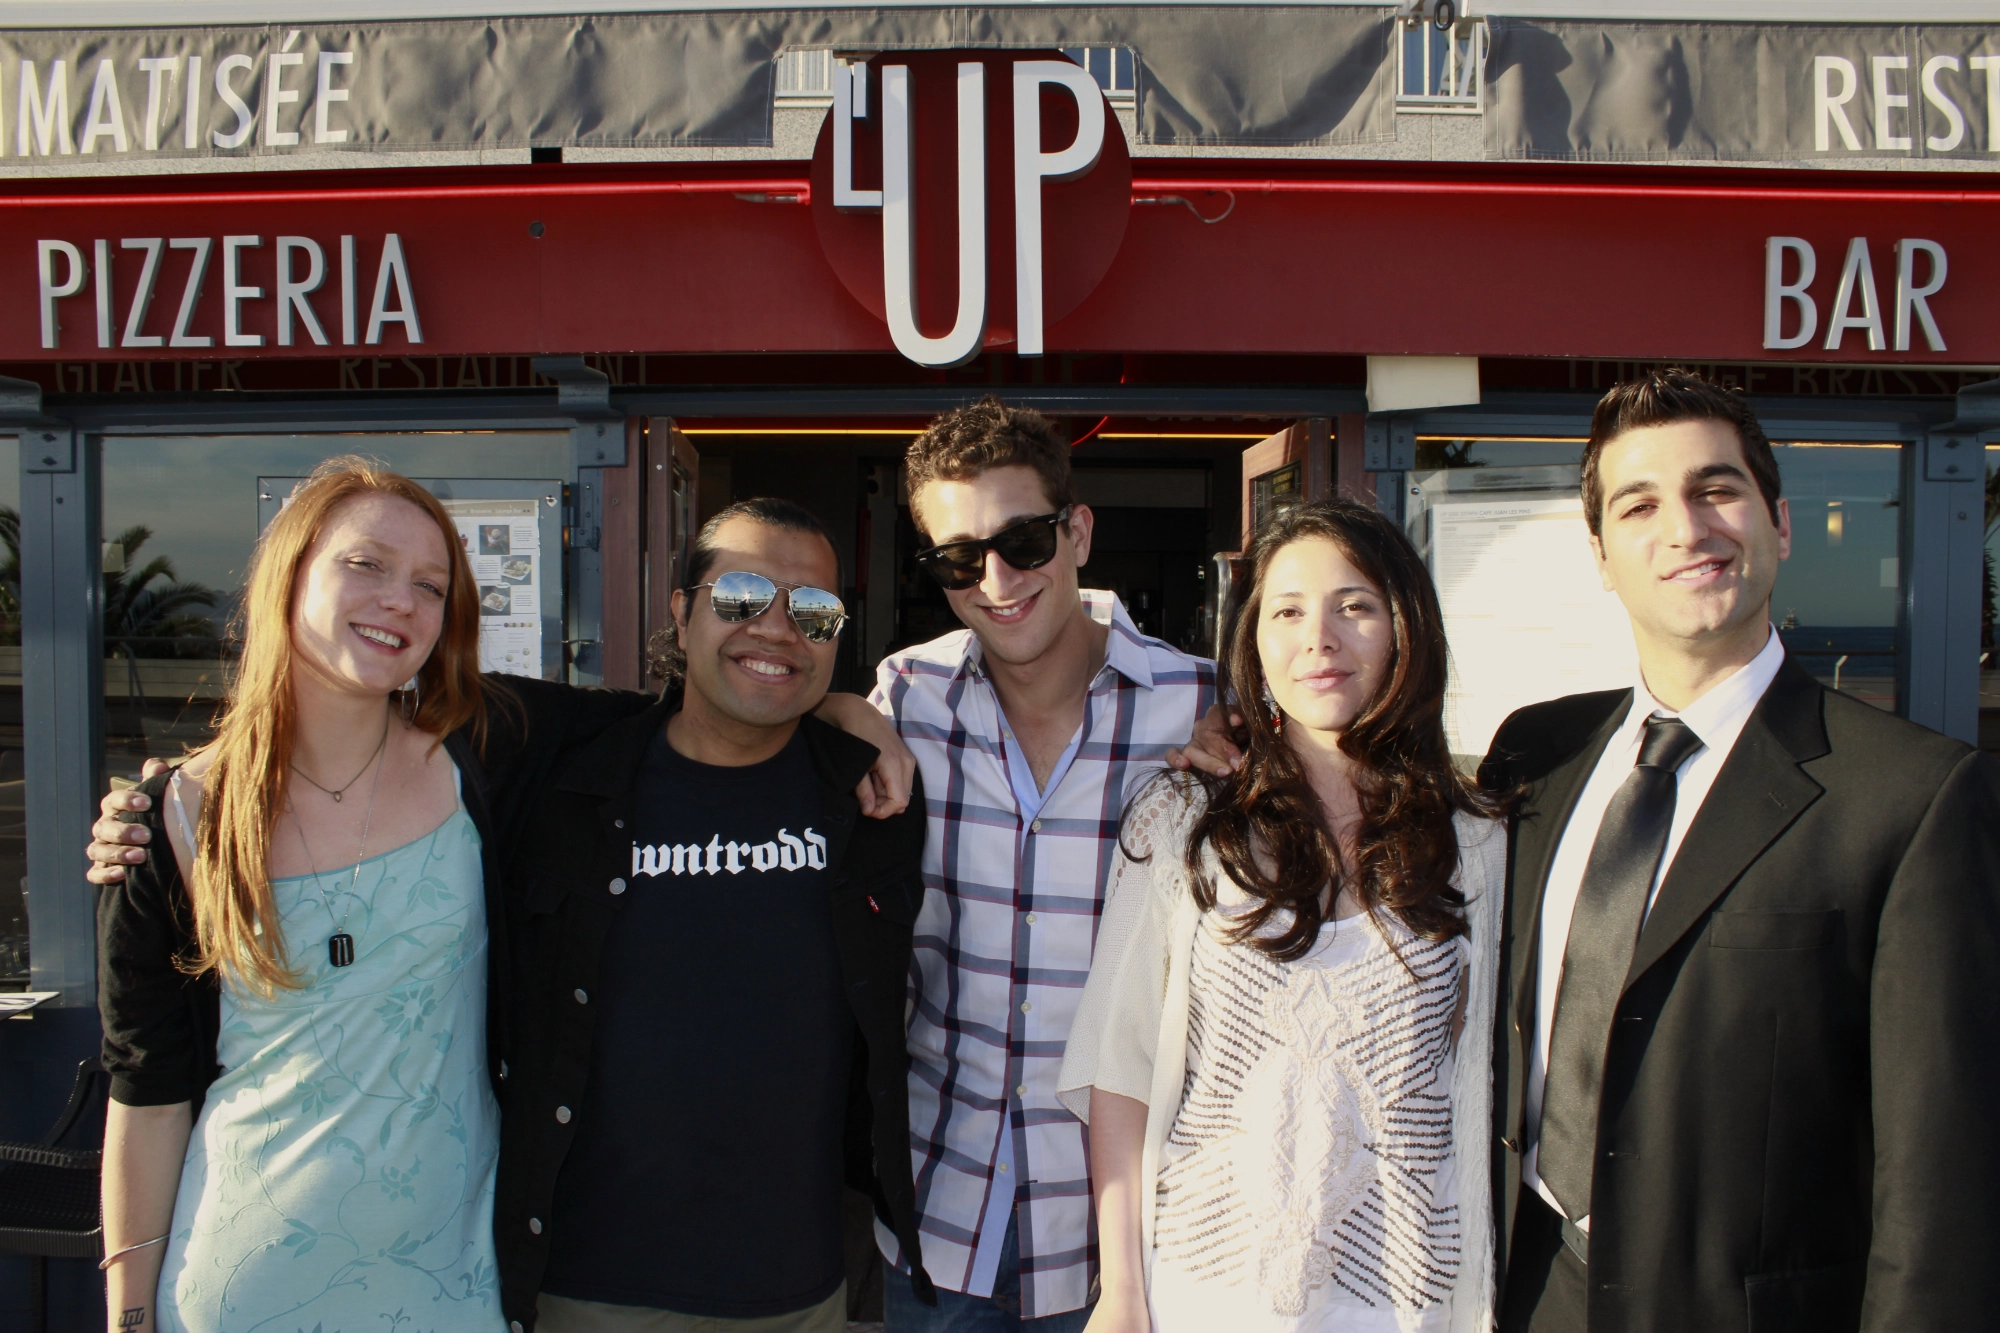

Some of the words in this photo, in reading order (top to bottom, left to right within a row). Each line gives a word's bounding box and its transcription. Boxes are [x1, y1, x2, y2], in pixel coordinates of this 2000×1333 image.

[0, 30, 354, 158] MATISÉE
[37, 233, 424, 349] PIZZERIA
[1763, 236, 1948, 351] BAR
